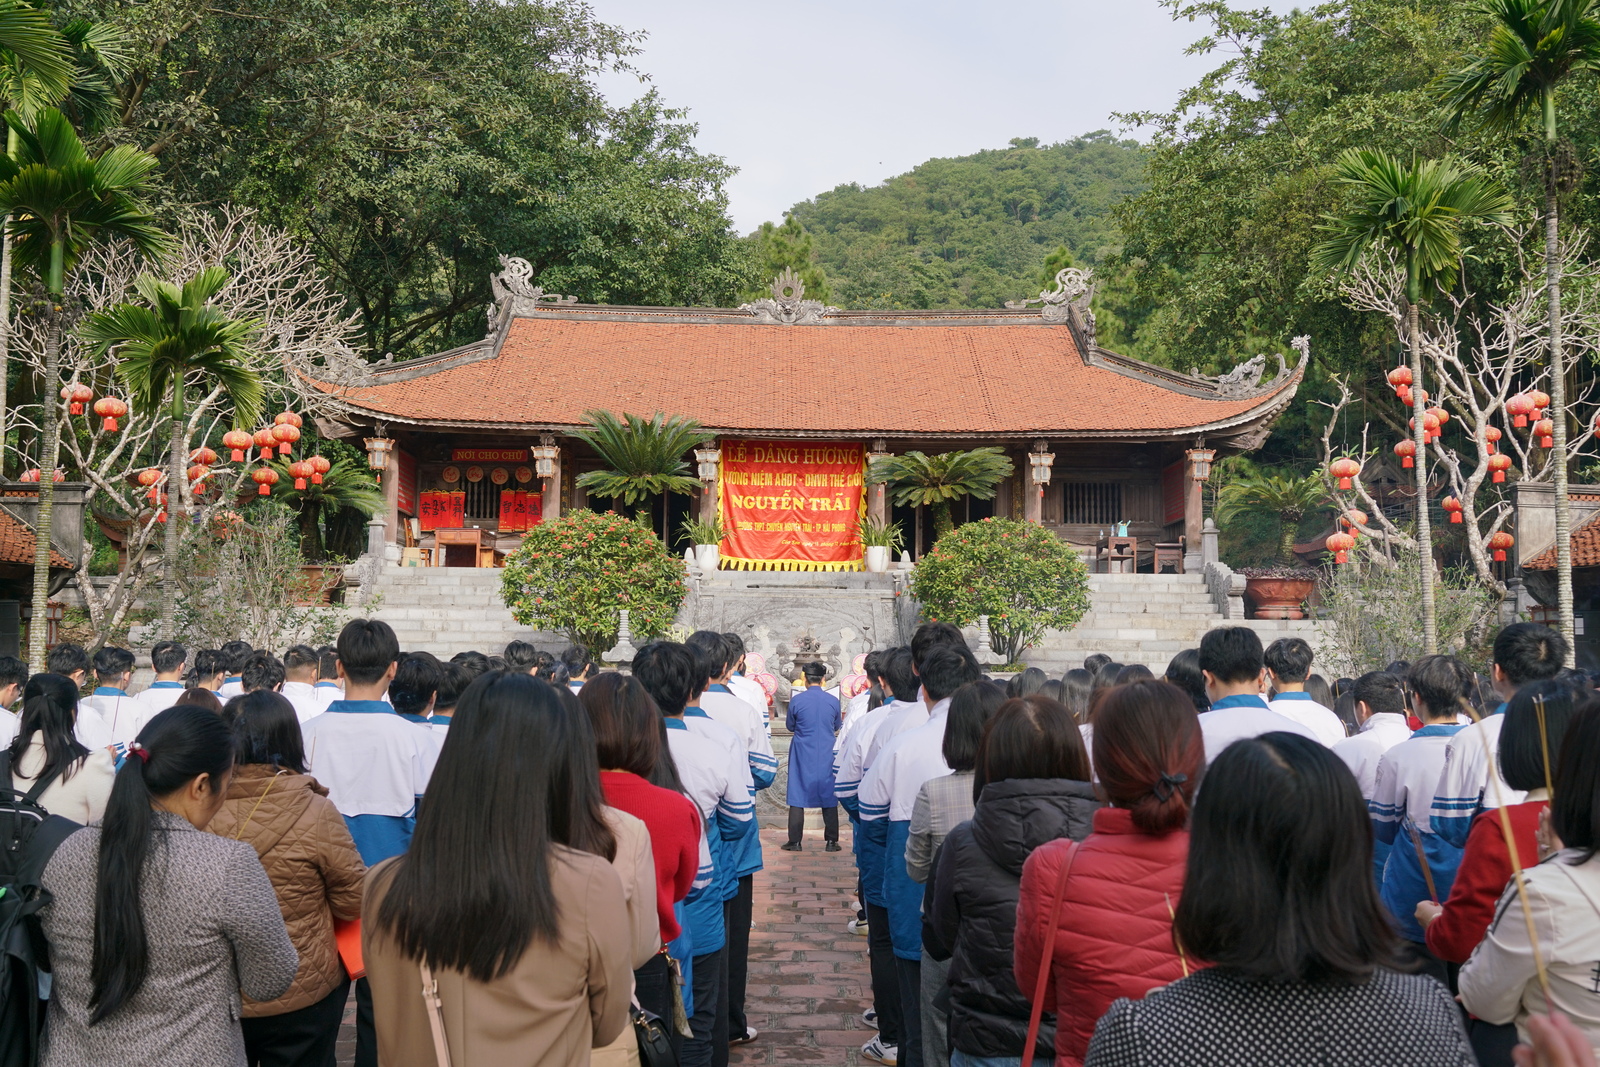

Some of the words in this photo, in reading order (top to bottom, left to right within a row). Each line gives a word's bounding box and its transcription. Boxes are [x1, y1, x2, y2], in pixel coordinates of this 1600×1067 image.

[456, 451, 475, 460] NƠI
[478, 451, 499, 460] CHO
[501, 449, 523, 460] CHỮ
[728, 440, 747, 462] LỄ
[753, 443, 799, 464] DÂNG
[803, 446, 859, 464] HƯƠNG
[751, 470, 773, 488] NIỆM
[805, 473, 828, 487] DNVH
[829, 469, 845, 487] THẾ
[847, 469, 862, 487] GIỚI
[731, 489, 805, 510] NGUYỄN
[809, 492, 851, 511] TRÃI
